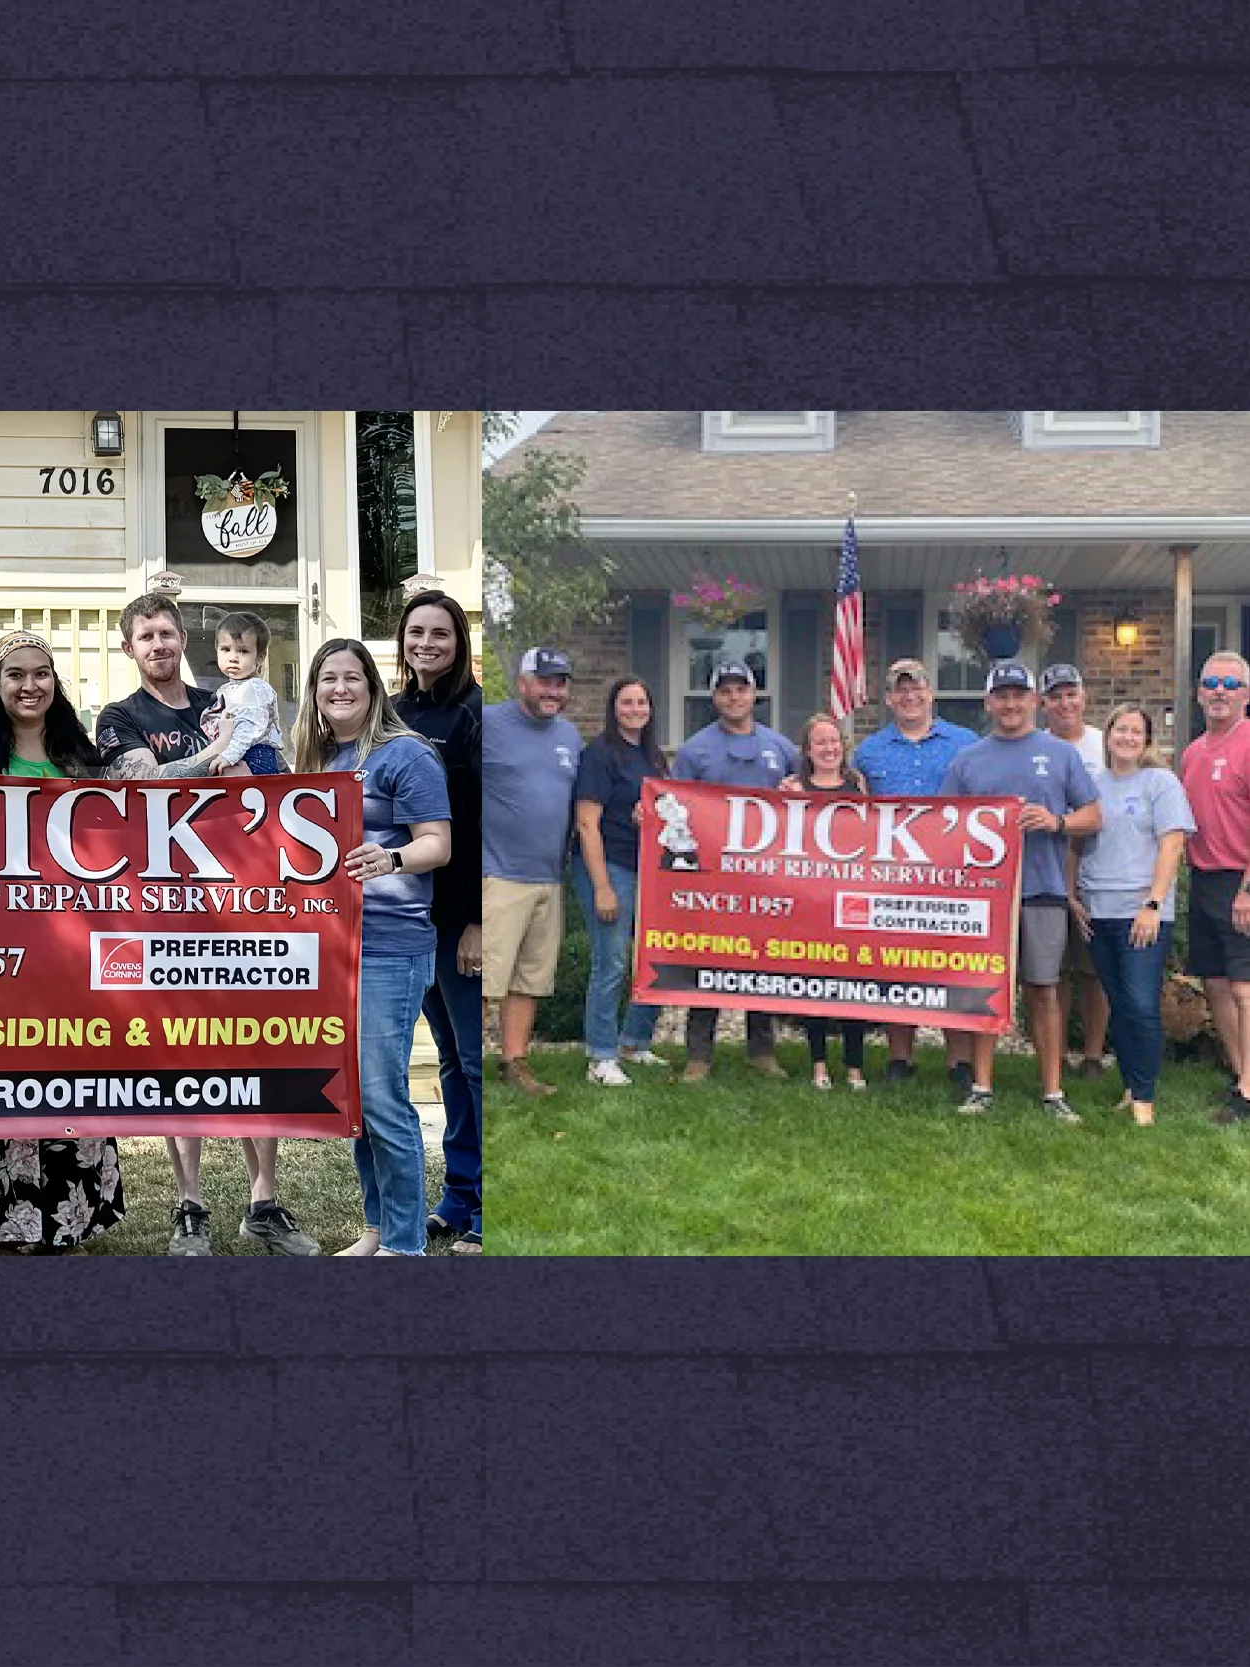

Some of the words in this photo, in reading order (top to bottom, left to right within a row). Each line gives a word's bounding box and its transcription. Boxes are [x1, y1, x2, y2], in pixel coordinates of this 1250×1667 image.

[39, 467, 115, 495] 7016
[215, 504, 269, 549] fall
[721, 796, 1007, 869] DICK'S
[720, 855, 781, 876] ROOF
[784, 859, 866, 882] REPAIR
[6, 884, 134, 914] REPAIR
[141, 885, 298, 918] SERVICE,
[303, 898, 340, 914] INC.
[671, 891, 743, 914] SINCE
[750, 896, 795, 917] 1957
[874, 915, 982, 933] CONTRACTOR
[150, 939, 289, 957] PREFERRED
[645, 929, 760, 960] ROOFING,
[765, 939, 849, 963] SIDING
[856, 945, 873, 965] &
[880, 946, 1006, 974] WINDOWS
[103, 970, 142, 978] CORNING
[110, 962, 141, 970] OWENS
[150, 967, 310, 985] CONTRACTOR
[697, 969, 947, 1008] DICKSROOFING.COM
[125, 1017, 150, 1047] &
[162, 1016, 346, 1046] WINDOWS
